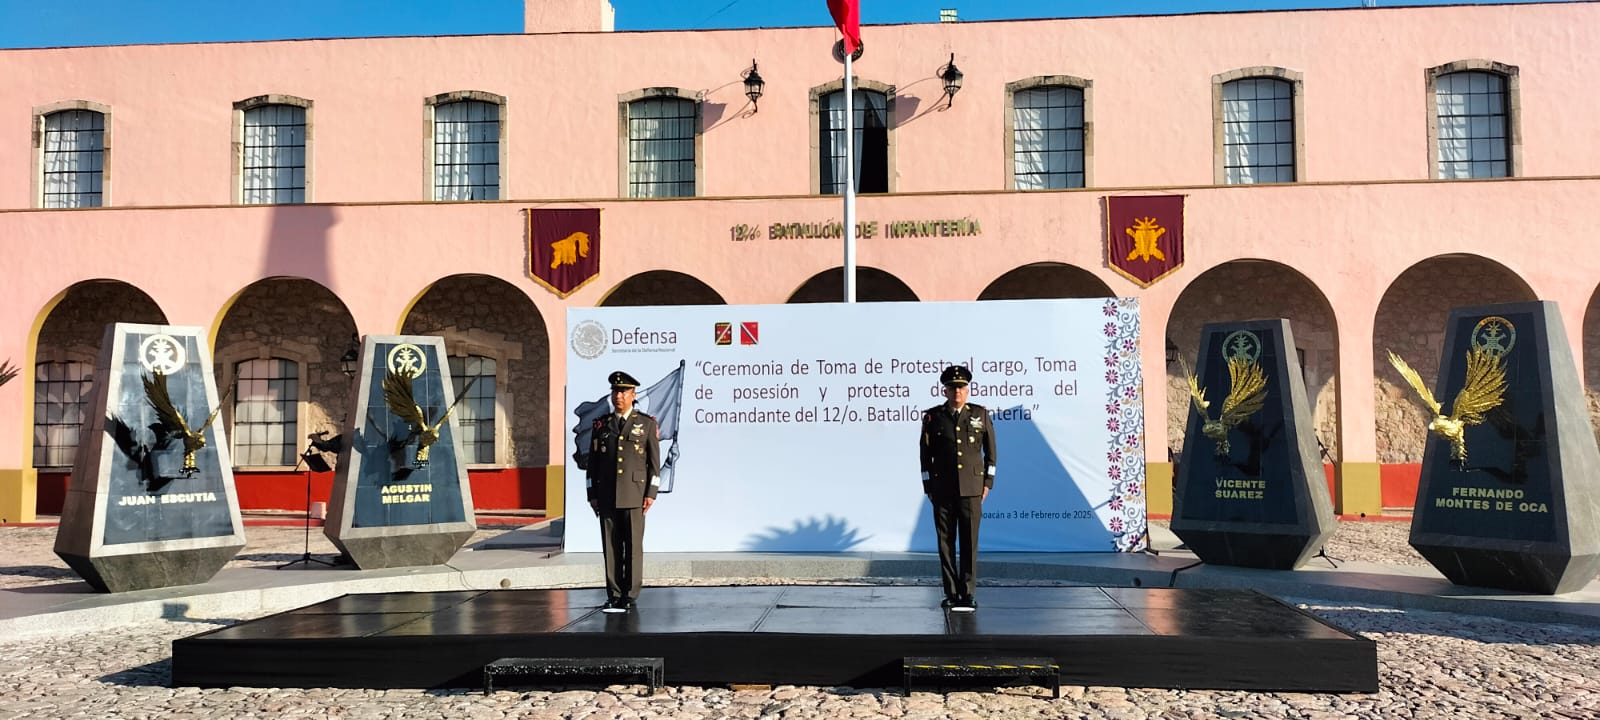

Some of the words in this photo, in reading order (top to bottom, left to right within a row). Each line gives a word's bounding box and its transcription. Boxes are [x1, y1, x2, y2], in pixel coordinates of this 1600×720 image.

[770, 217, 845, 239] BATALLÓN
[857, 221, 877, 238] DE
[886, 214, 981, 238] INFANTERÍA
[612, 327, 677, 345] Defensa
[695, 359, 783, 377] “Ceremonia
[791, 359, 809, 375] de
[816, 359, 857, 375] Toma
[865, 358, 883, 374] de
[981, 360, 1028, 377] cargo,
[1034, 356, 1077, 373] Toma
[695, 384, 713, 400] de
[733, 382, 799, 403] posesión
[818, 386, 828, 402] y
[848, 384, 910, 402] protesta
[970, 380, 1034, 397] Bandera
[1054, 380, 1077, 396] del
[695, 407, 790, 424] Comandante
[795, 406, 818, 423] del
[823, 405, 862, 425] 12/o.
[381, 483, 432, 494] AGUSTIN
[1216, 476, 1265, 489] VICENTE
[118, 495, 156, 506] JUAN
[161, 492, 216, 504] ESCUTIA
[382, 494, 430, 504] MELGAR
[1215, 489, 1264, 499] SUAREZ
[1452, 487, 1524, 499] FERNANDO
[1435, 498, 1490, 510] MONTES
[1495, 501, 1513, 511] DE
[1519, 502, 1548, 513] OCA
[1013, 510, 1018, 519] 3
[1020, 509, 1029, 519] de
[1031, 510, 1060, 519] Febrero
[1062, 510, 1071, 519] de
